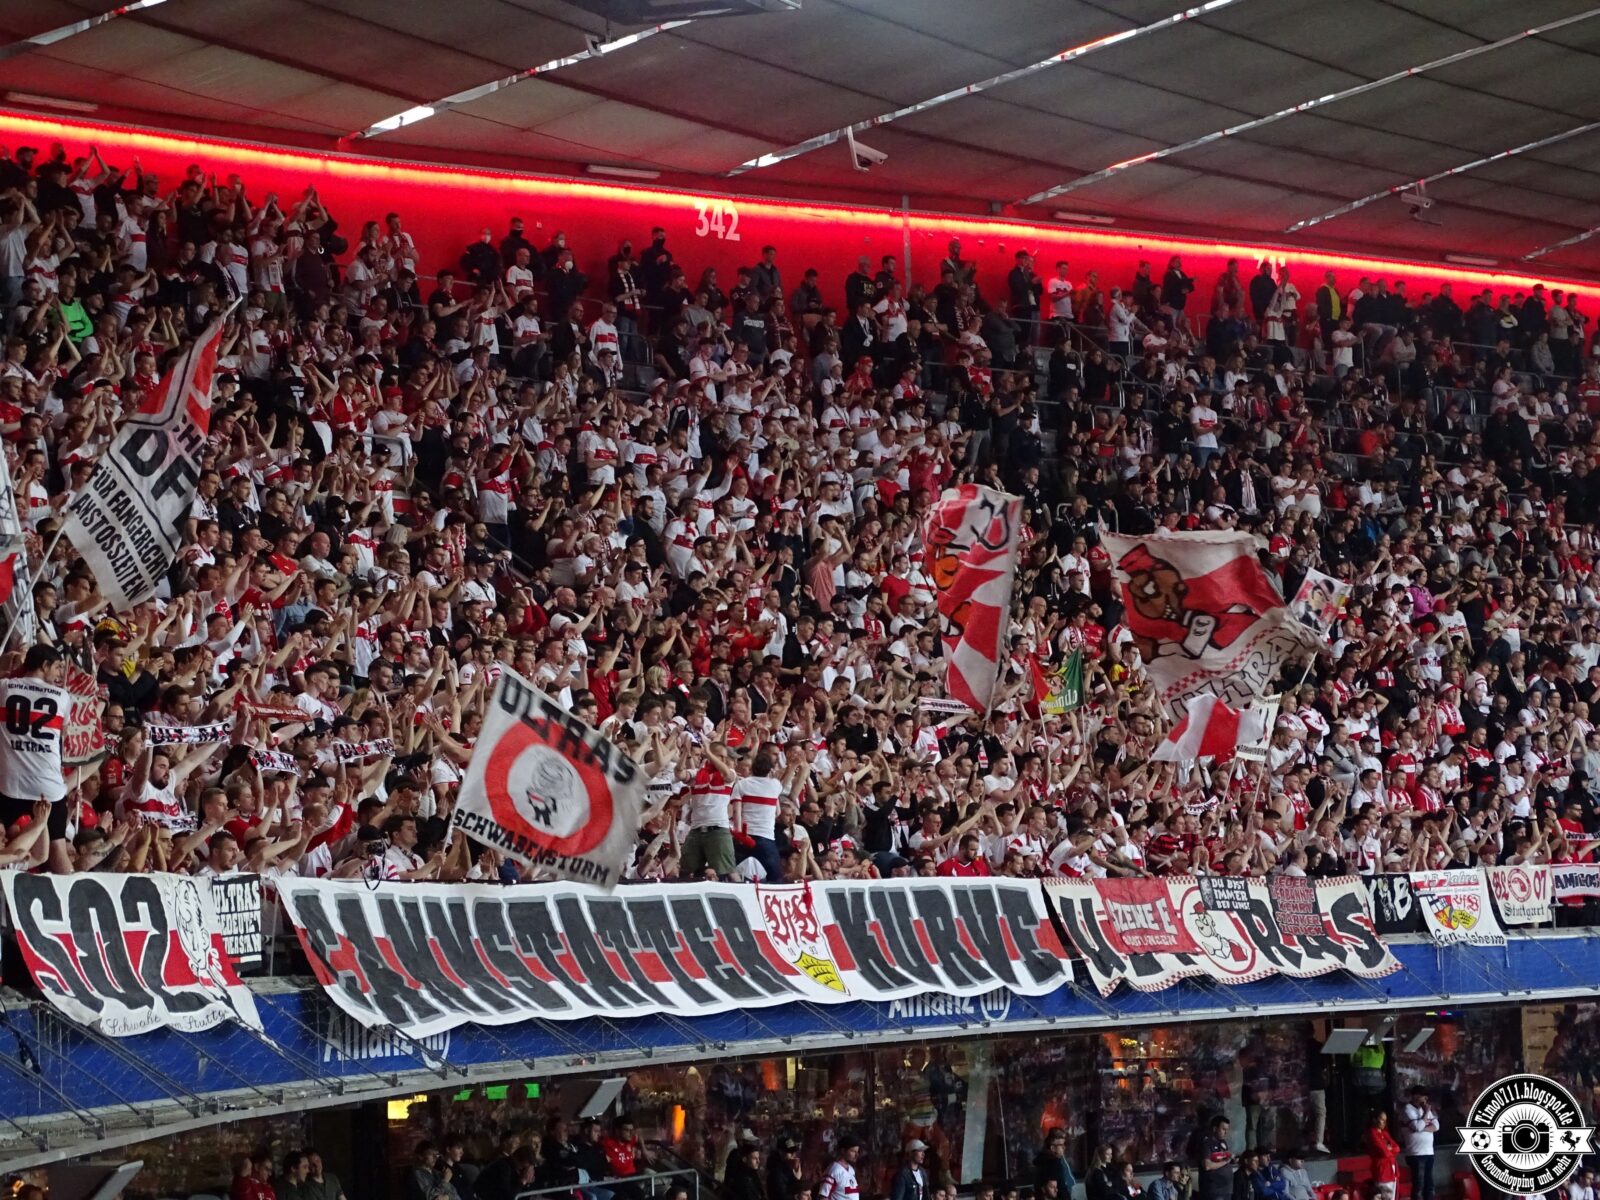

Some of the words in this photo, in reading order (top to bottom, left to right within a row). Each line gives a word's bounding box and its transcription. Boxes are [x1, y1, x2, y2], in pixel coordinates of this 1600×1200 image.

[694, 198, 740, 241] 342
[6, 695, 58, 740] 02
[499, 672, 637, 784] ULTRAS
[453, 808, 610, 886] SCHWABENSTURM
[213, 881, 261, 914] ULTRAS
[1211, 878, 1225, 890] DU
[1213, 889, 1249, 901] IMMER
[1273, 876, 1307, 888] JEDER
[1106, 898, 1161, 935] SZENE
[1155, 897, 1178, 935] E
[1503, 902, 1545, 920] Stuttgart
[292, 889, 809, 1028] CANNSTATTER
[825, 884, 1066, 992] KURVE
